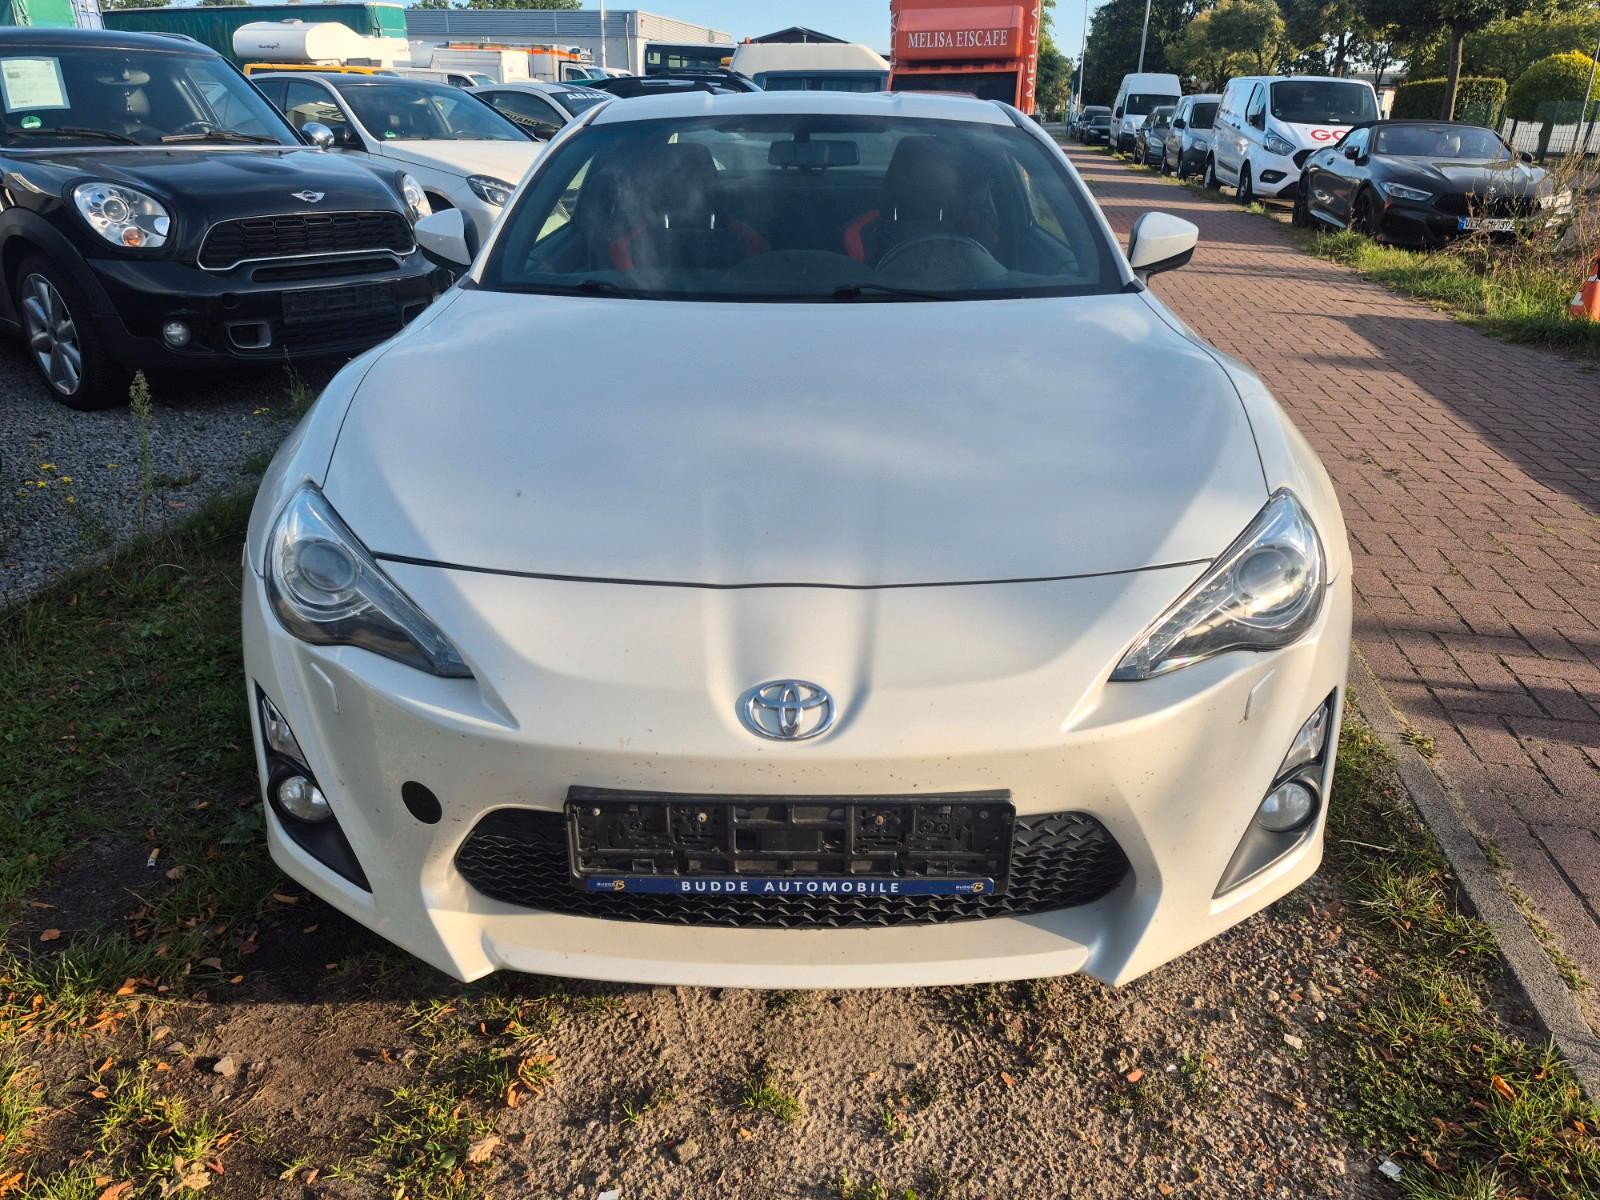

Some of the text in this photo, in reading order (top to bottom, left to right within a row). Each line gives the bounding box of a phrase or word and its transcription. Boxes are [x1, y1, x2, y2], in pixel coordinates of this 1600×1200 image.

[908, 30, 1008, 48] MELISA EISCAFE
[681, 881, 899, 892] BUDDE AUTOMOBILE
